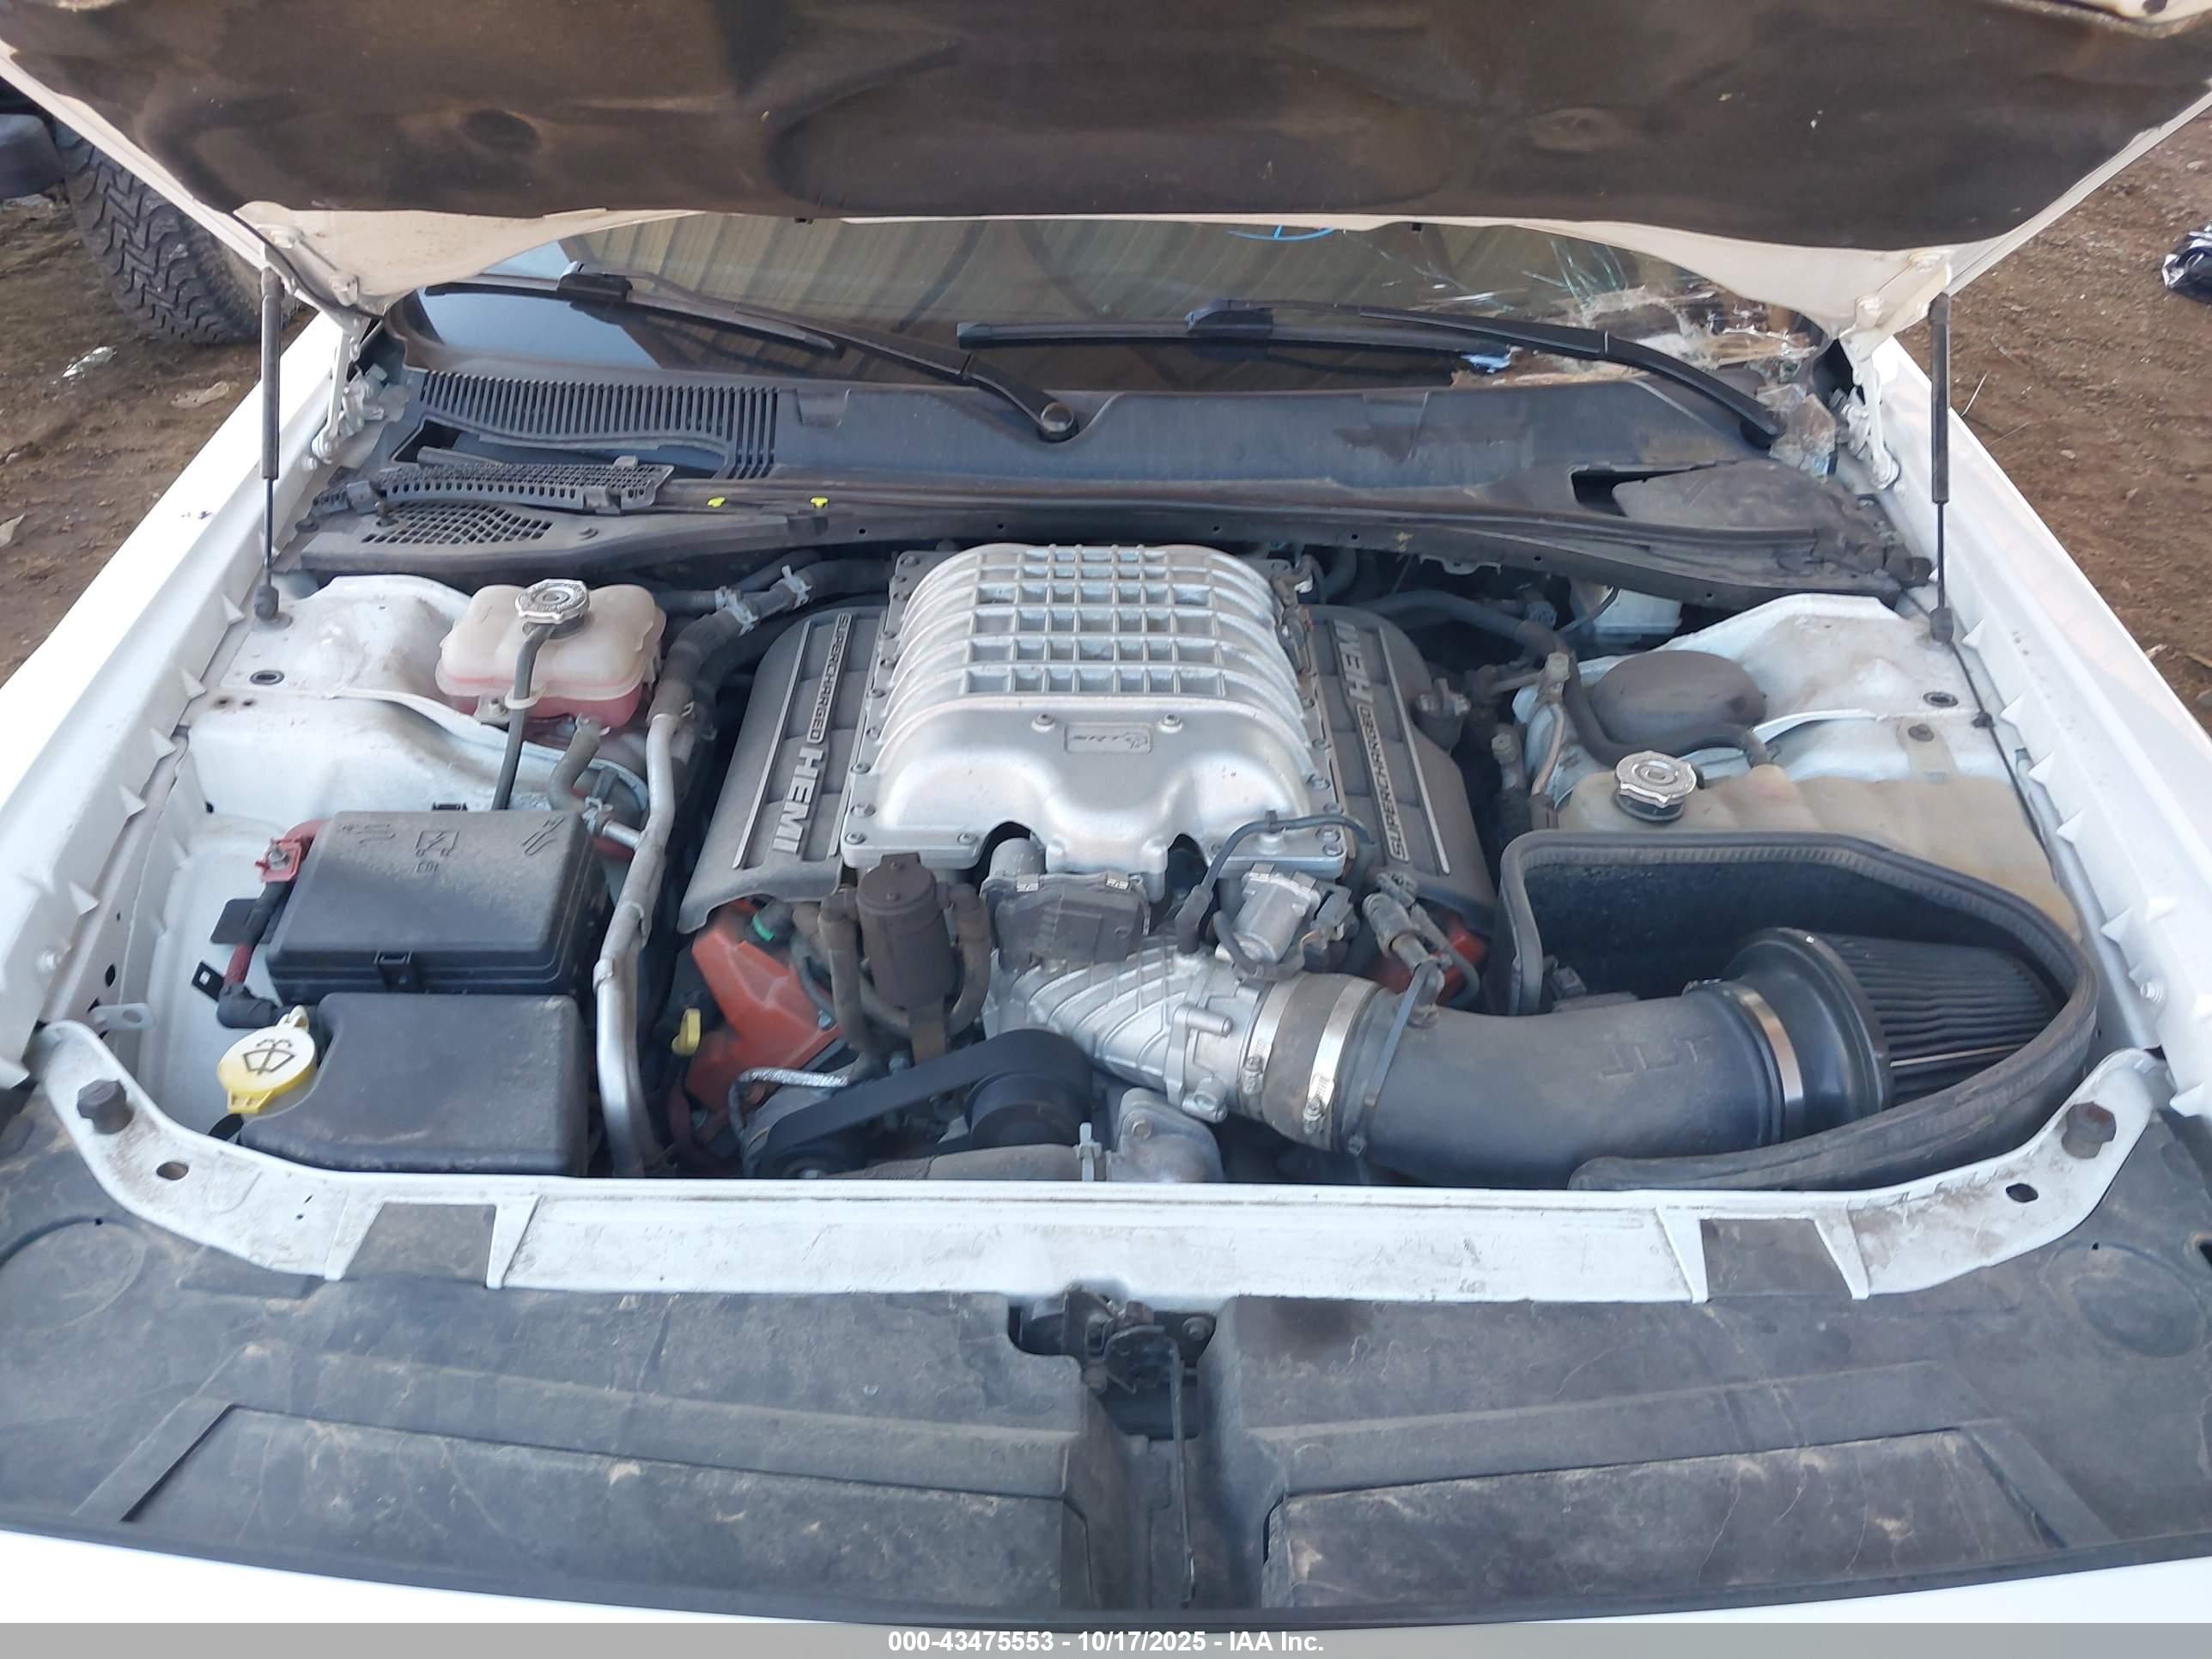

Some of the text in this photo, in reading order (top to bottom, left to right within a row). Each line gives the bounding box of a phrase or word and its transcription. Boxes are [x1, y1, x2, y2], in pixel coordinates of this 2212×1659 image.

[773, 613, 850, 855] SUPERCHARGED HEMI
[1334, 619, 1407, 860] SUPERCHARGED HEMI
